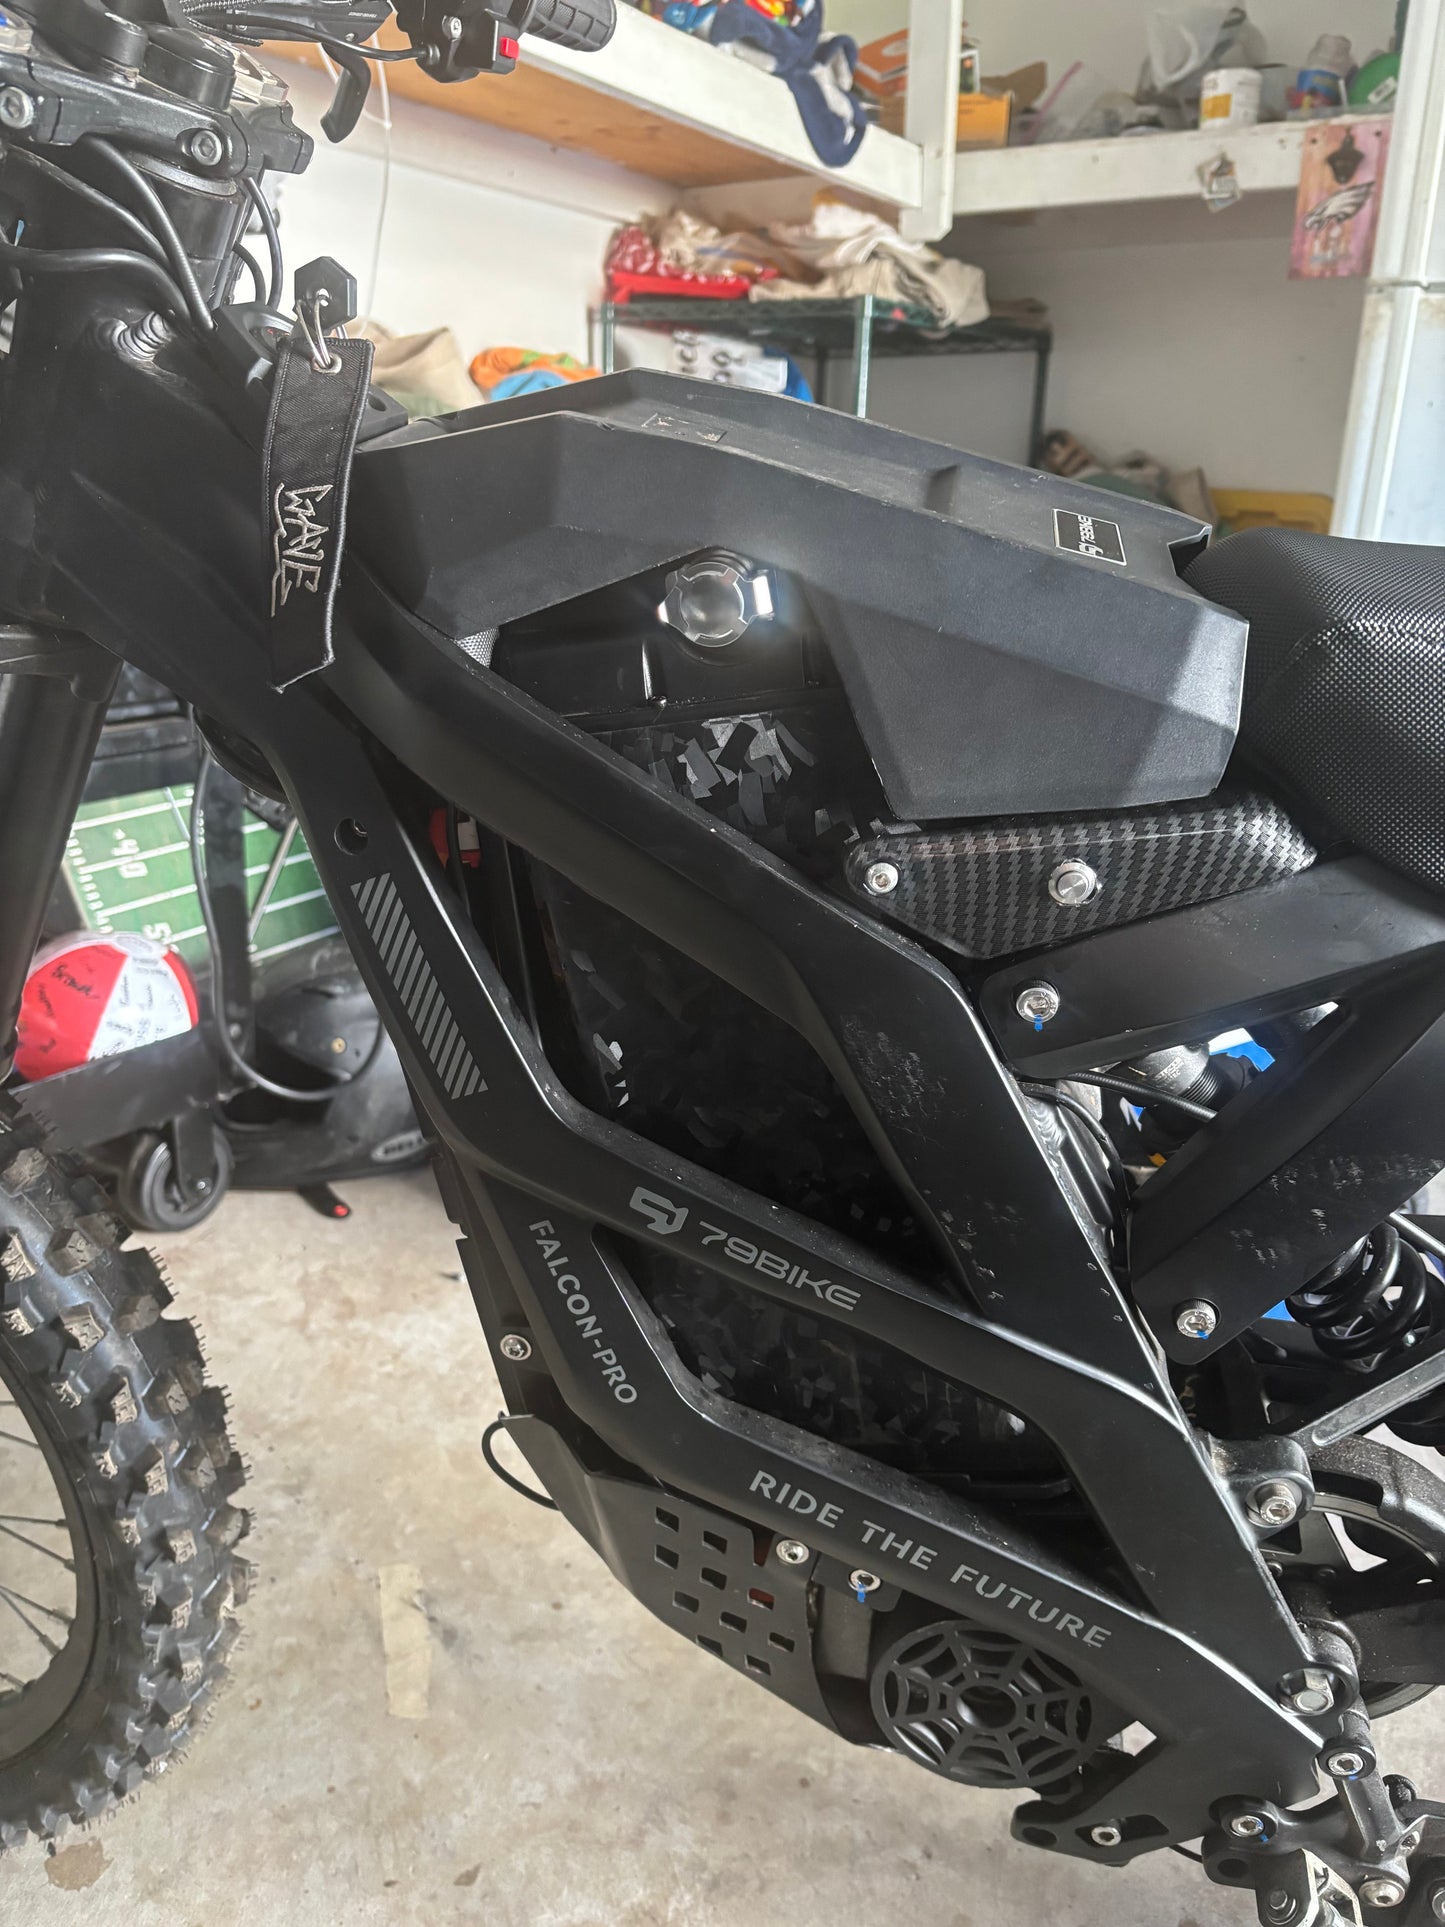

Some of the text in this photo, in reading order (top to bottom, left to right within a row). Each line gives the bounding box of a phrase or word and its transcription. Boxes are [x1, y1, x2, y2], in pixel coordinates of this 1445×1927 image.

[528, 1219, 638, 1404] FALCON-PRO
[699, 1220, 861, 1311] 79BIKE
[749, 1470, 1112, 1649] RIDE THE FUTURE
